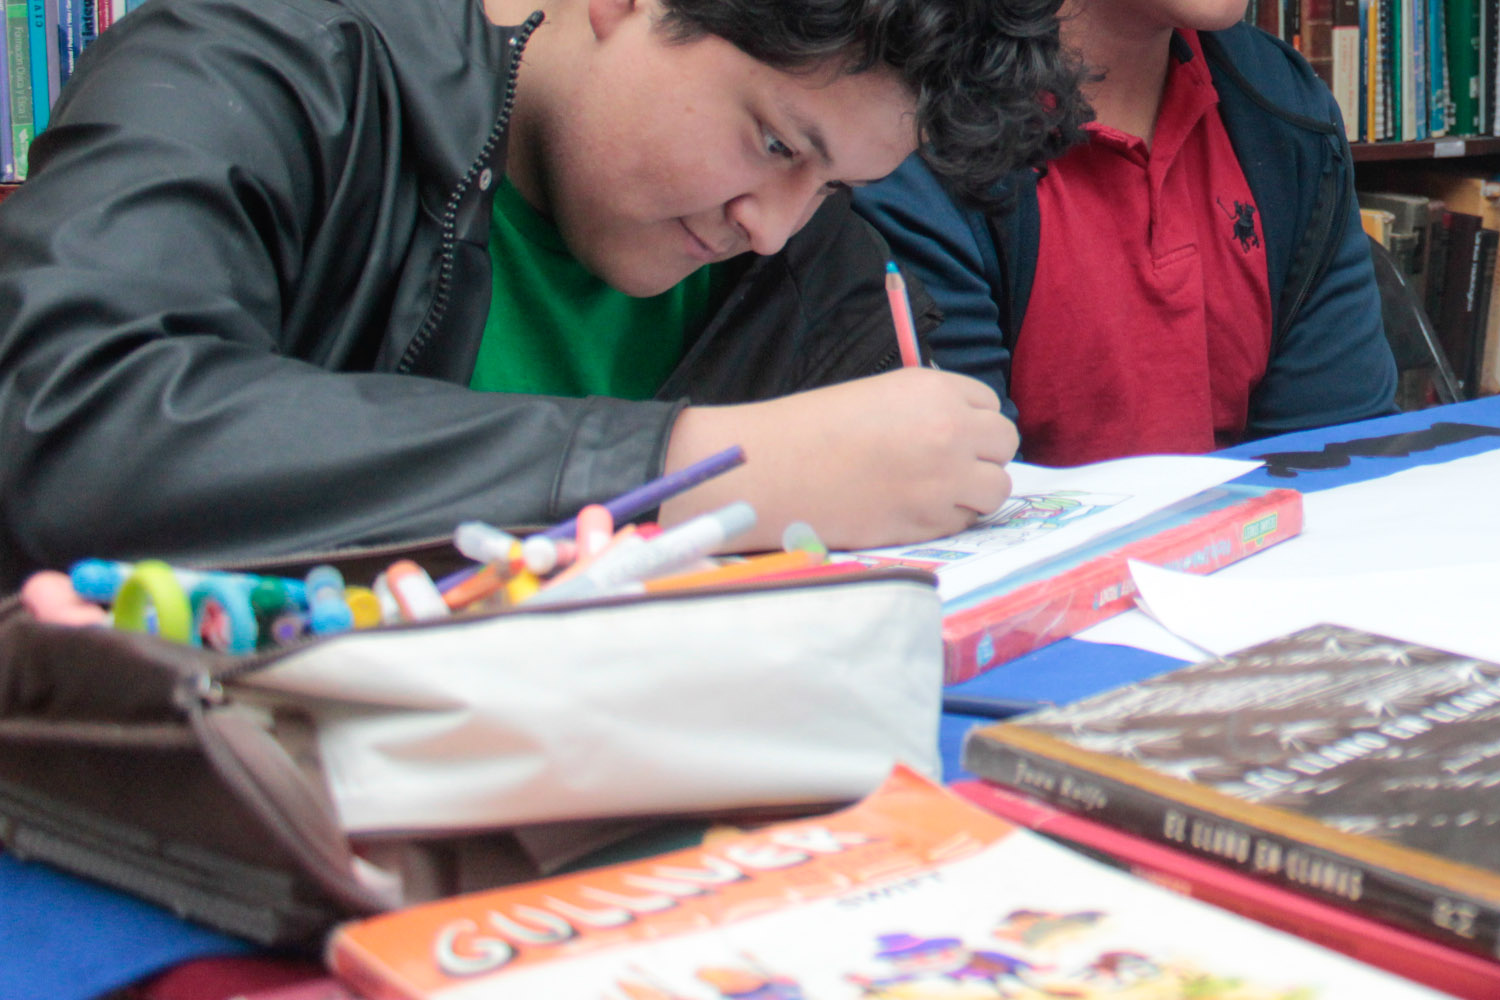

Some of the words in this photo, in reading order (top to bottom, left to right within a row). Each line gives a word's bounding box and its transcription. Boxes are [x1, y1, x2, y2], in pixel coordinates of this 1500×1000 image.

[1163, 808, 1188, 843] EL
[1189, 820, 1252, 864] LLANO
[432, 825, 862, 977] GULLIVER
